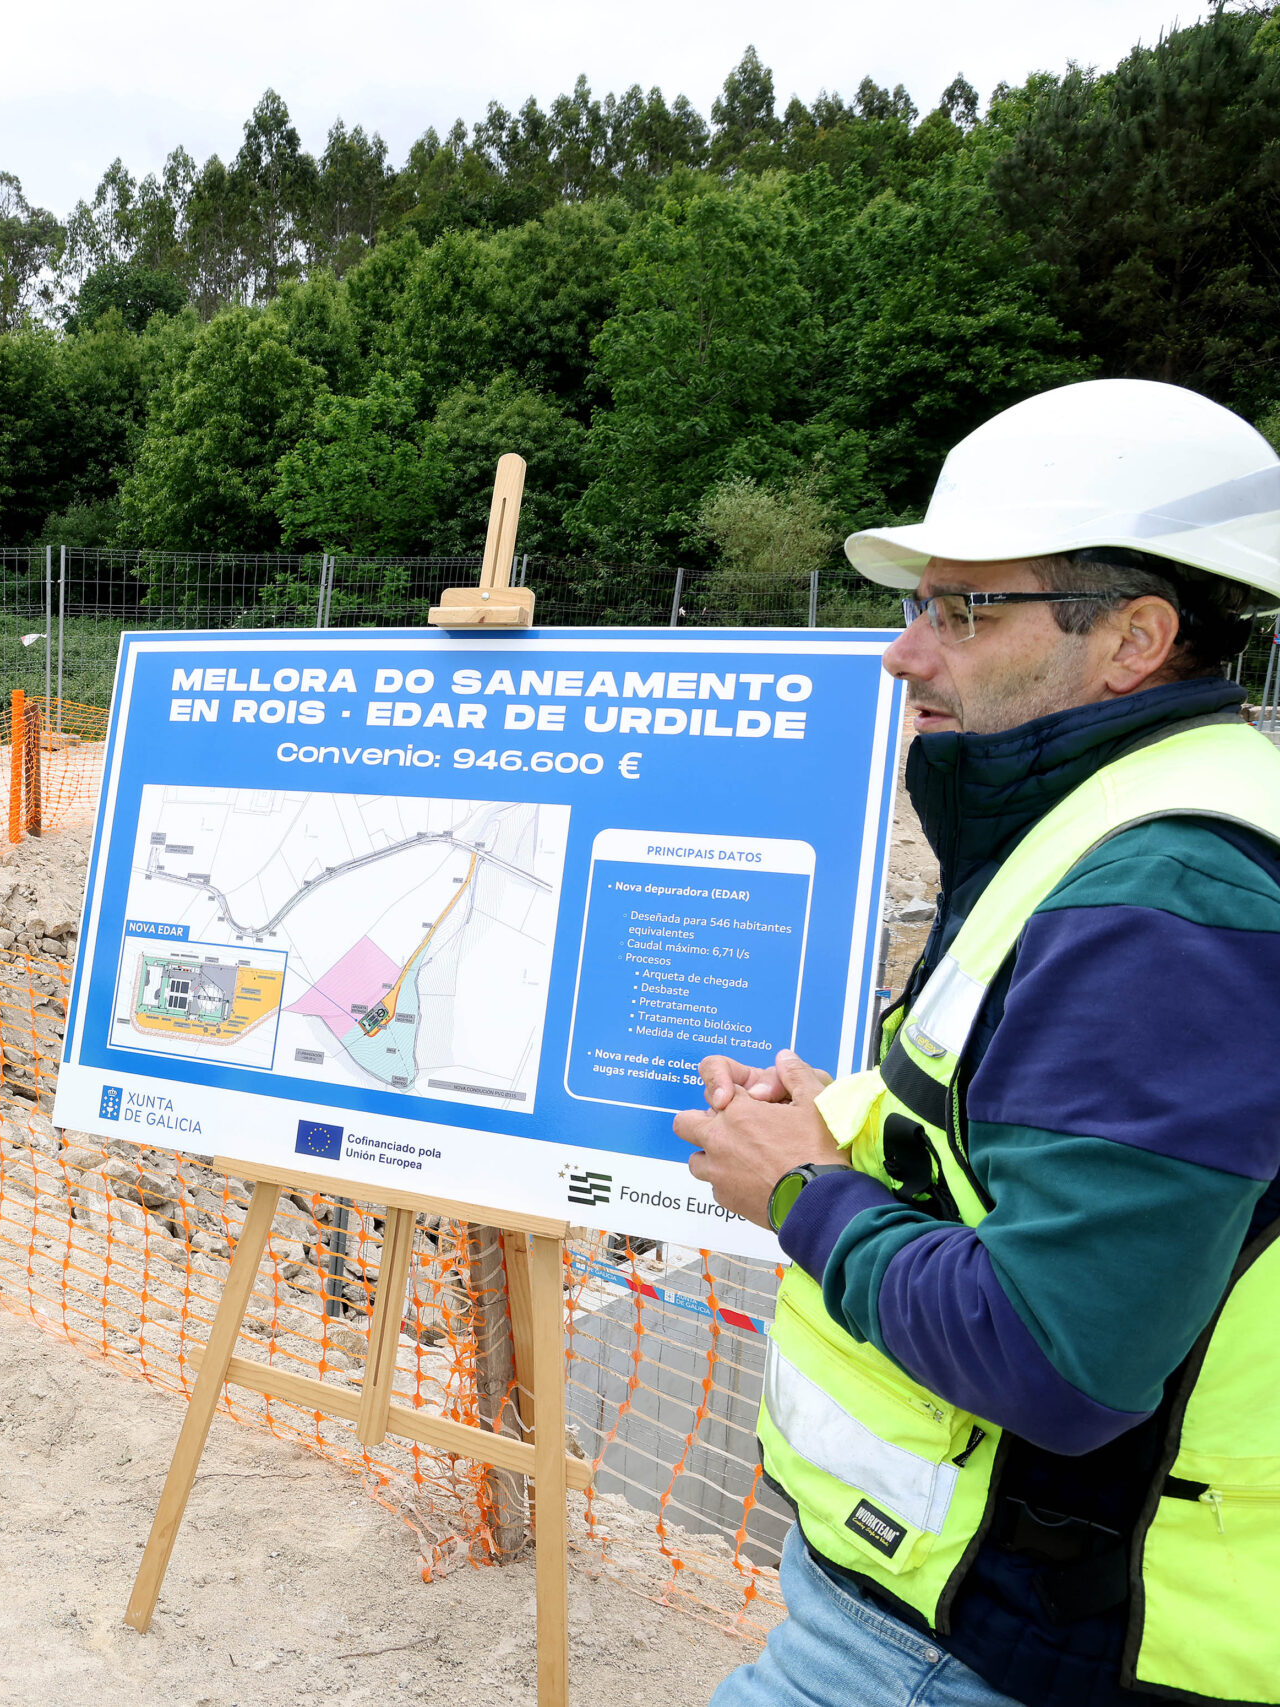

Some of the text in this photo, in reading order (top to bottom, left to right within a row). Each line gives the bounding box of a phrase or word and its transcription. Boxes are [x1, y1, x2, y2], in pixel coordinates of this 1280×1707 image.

[171, 667, 813, 702] MELLORA DO SANEAMENTO
[169, 698, 220, 723] EN
[232, 699, 326, 725] ROIS
[366, 701, 488, 729] EDAR
[504, 704, 567, 731] DE
[584, 706, 808, 740] URDILDE
[276, 742, 643, 779] Convenio: 946.600 €
[646, 845, 762, 863] PRINCIPAIS DATOS
[615, 881, 750, 902] Nova depuradora (EDAR)
[128, 922, 184, 937] NOVA EDAR
[628, 926, 695, 940] equivalentes
[630, 910, 792, 934] Deseñada para 546 habitantes
[625, 952, 672, 966] Procesos
[627, 938, 750, 960] Caudal máximo: 6,71 l/s
[641, 983, 690, 997] Desbaste
[642, 969, 749, 989] Arqueta de chegada
[639, 996, 718, 1014] Pretratamento
[638, 1011, 753, 1034] Tratamento biolóxico
[635, 1025, 773, 1051] Medida de caudal tratado
[595, 1048, 622, 1062] Nova
[624, 1053, 650, 1065] rede
[652, 1056, 666, 1066] de
[593, 1063, 625, 1077] augas
[627, 1067, 680, 1083] residuais:
[126, 1091, 174, 1113] XUNTA
[124, 1108, 203, 1135] DE GALICIA
[347, 1133, 442, 1160] Cofinanciado pola
[345, 1147, 423, 1171] Unión Europea
[620, 1185, 681, 1210] Fondos
[686, 1301, 711, 1315] GALICIA
